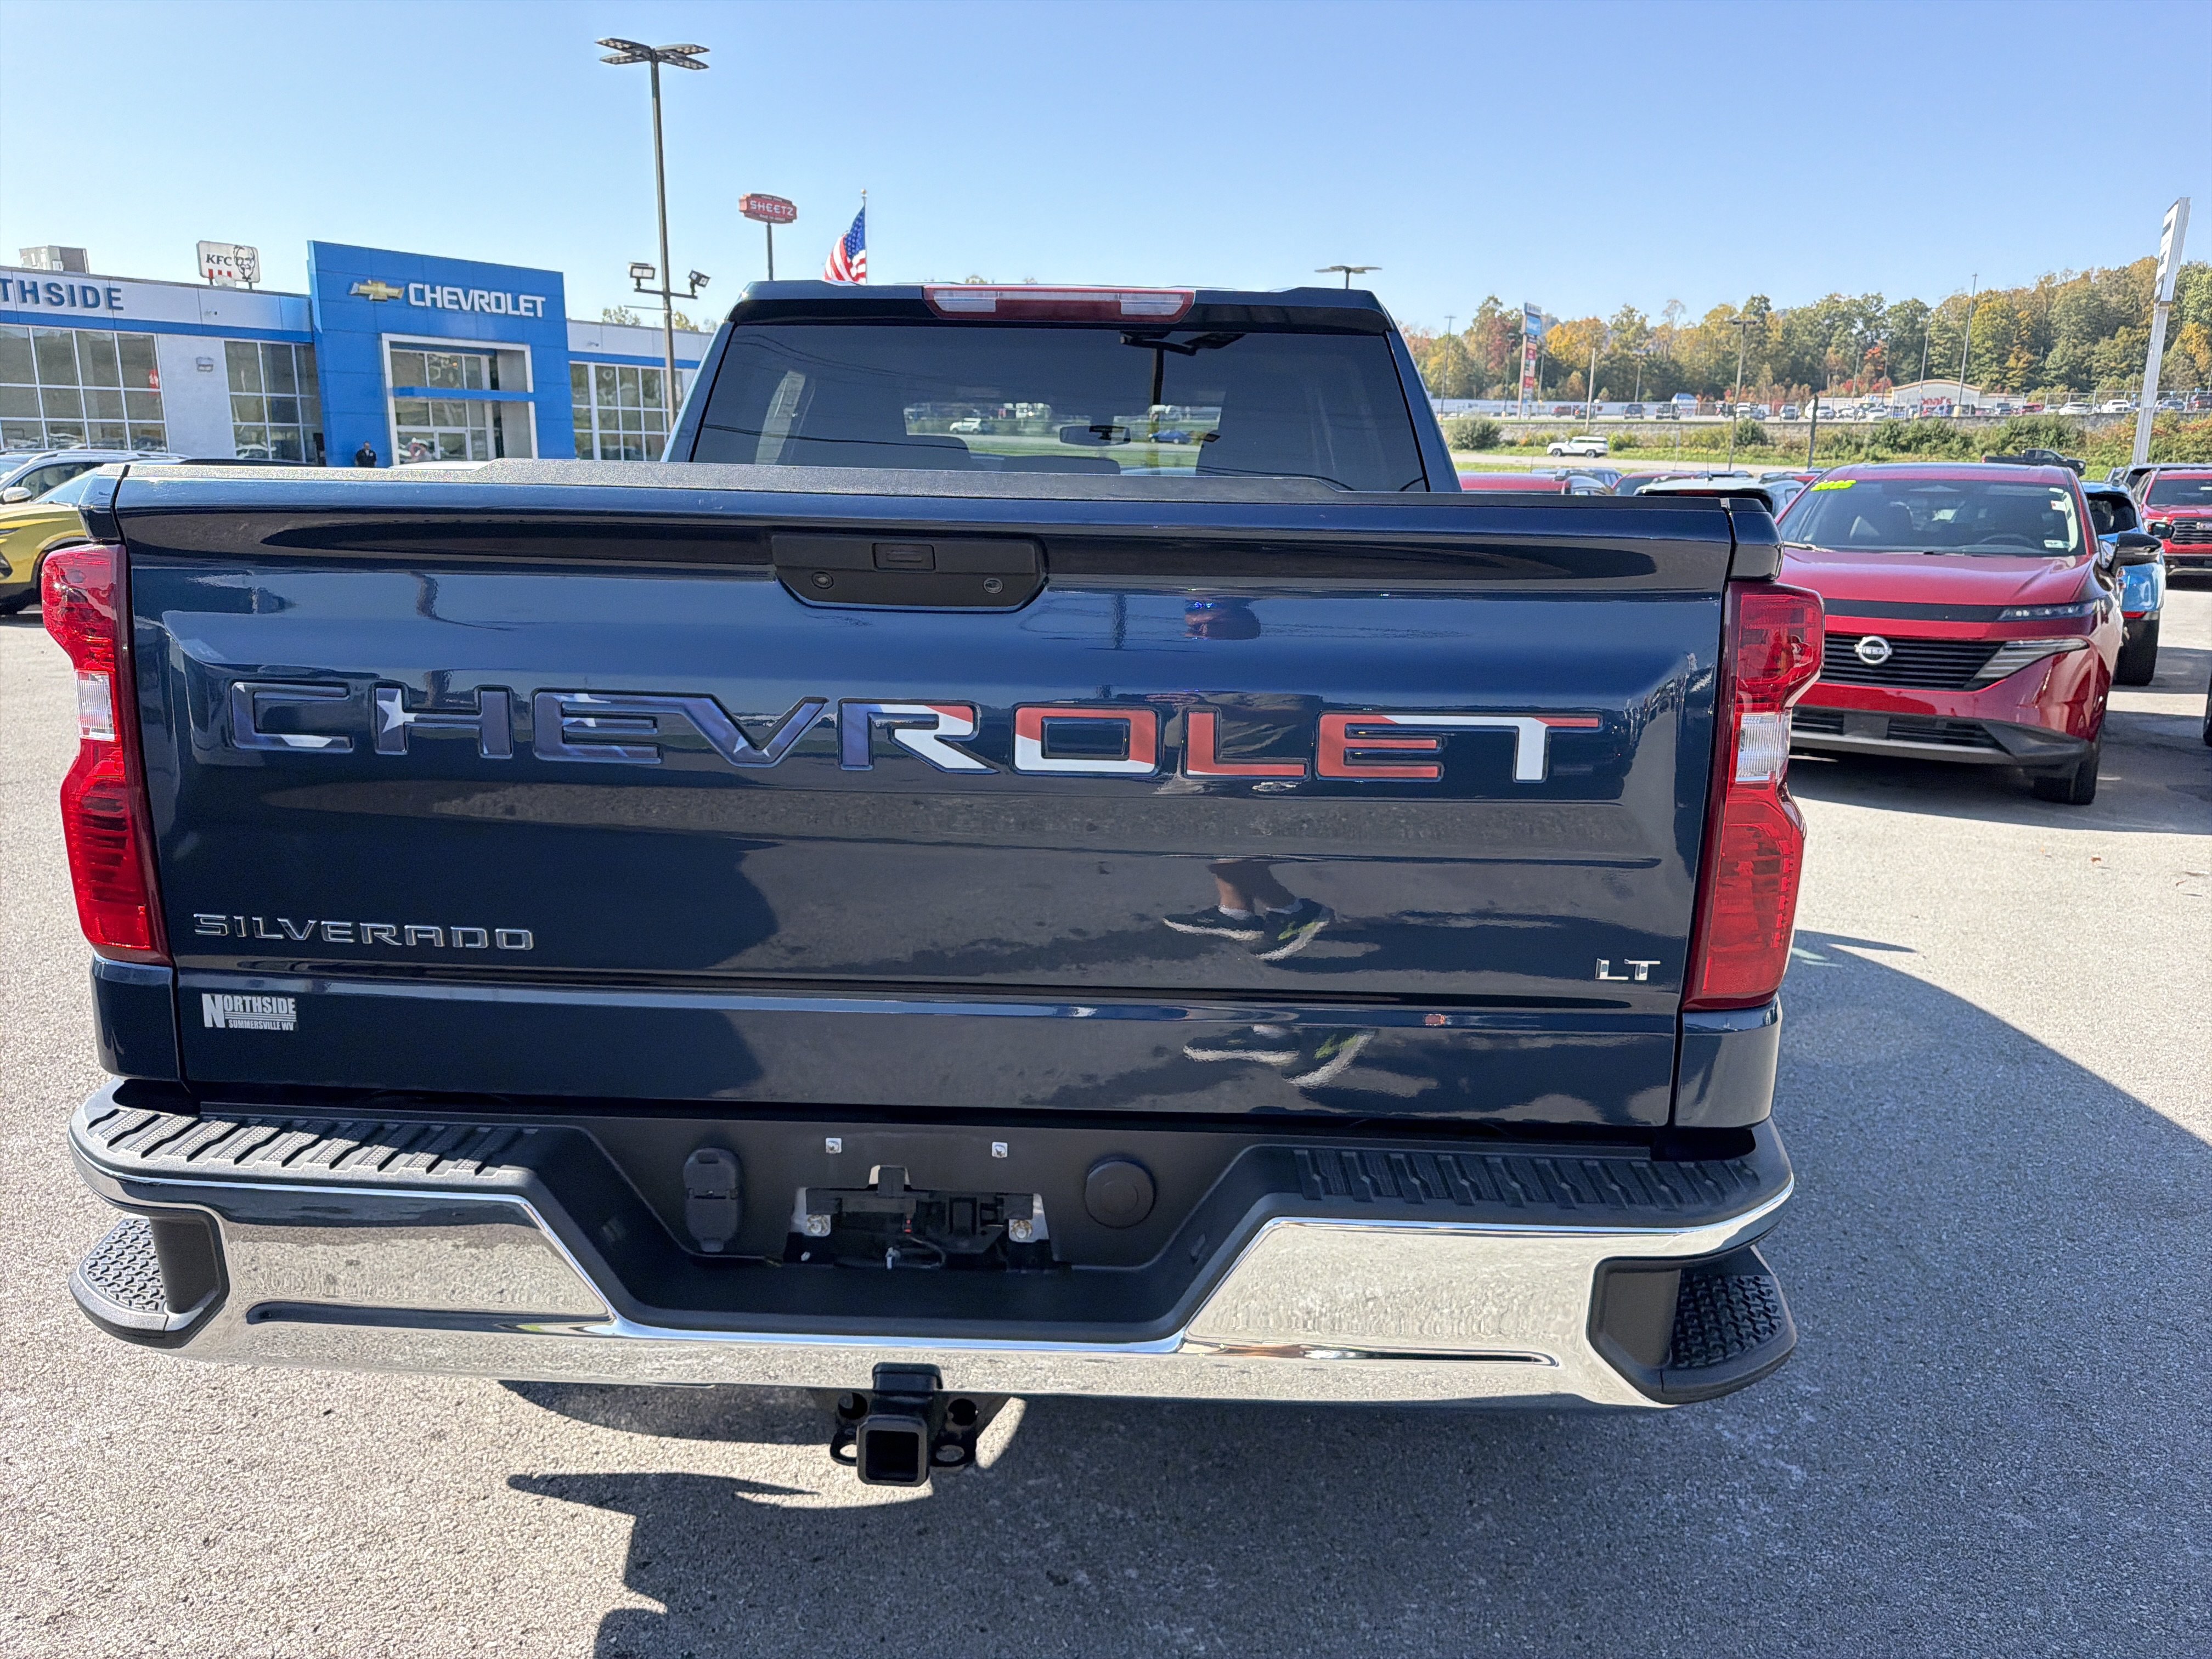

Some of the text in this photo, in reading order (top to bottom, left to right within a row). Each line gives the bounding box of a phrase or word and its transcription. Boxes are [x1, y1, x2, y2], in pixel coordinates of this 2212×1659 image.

[749, 200, 794, 216] SHEETZ
[205, 254, 232, 267] KFC
[0, 278, 124, 311] THSIDE
[408, 283, 546, 318] CHEVROLET
[1854, 644, 1892, 655] NISSAN
[230, 681, 1601, 782] CHEVROLET
[194, 913, 534, 950] SILVERADO
[1595, 958, 1661, 980] LT
[202, 994, 297, 1028] NORTHSIDE
[228, 1019, 294, 1031] SUMMERSVILLE WV
